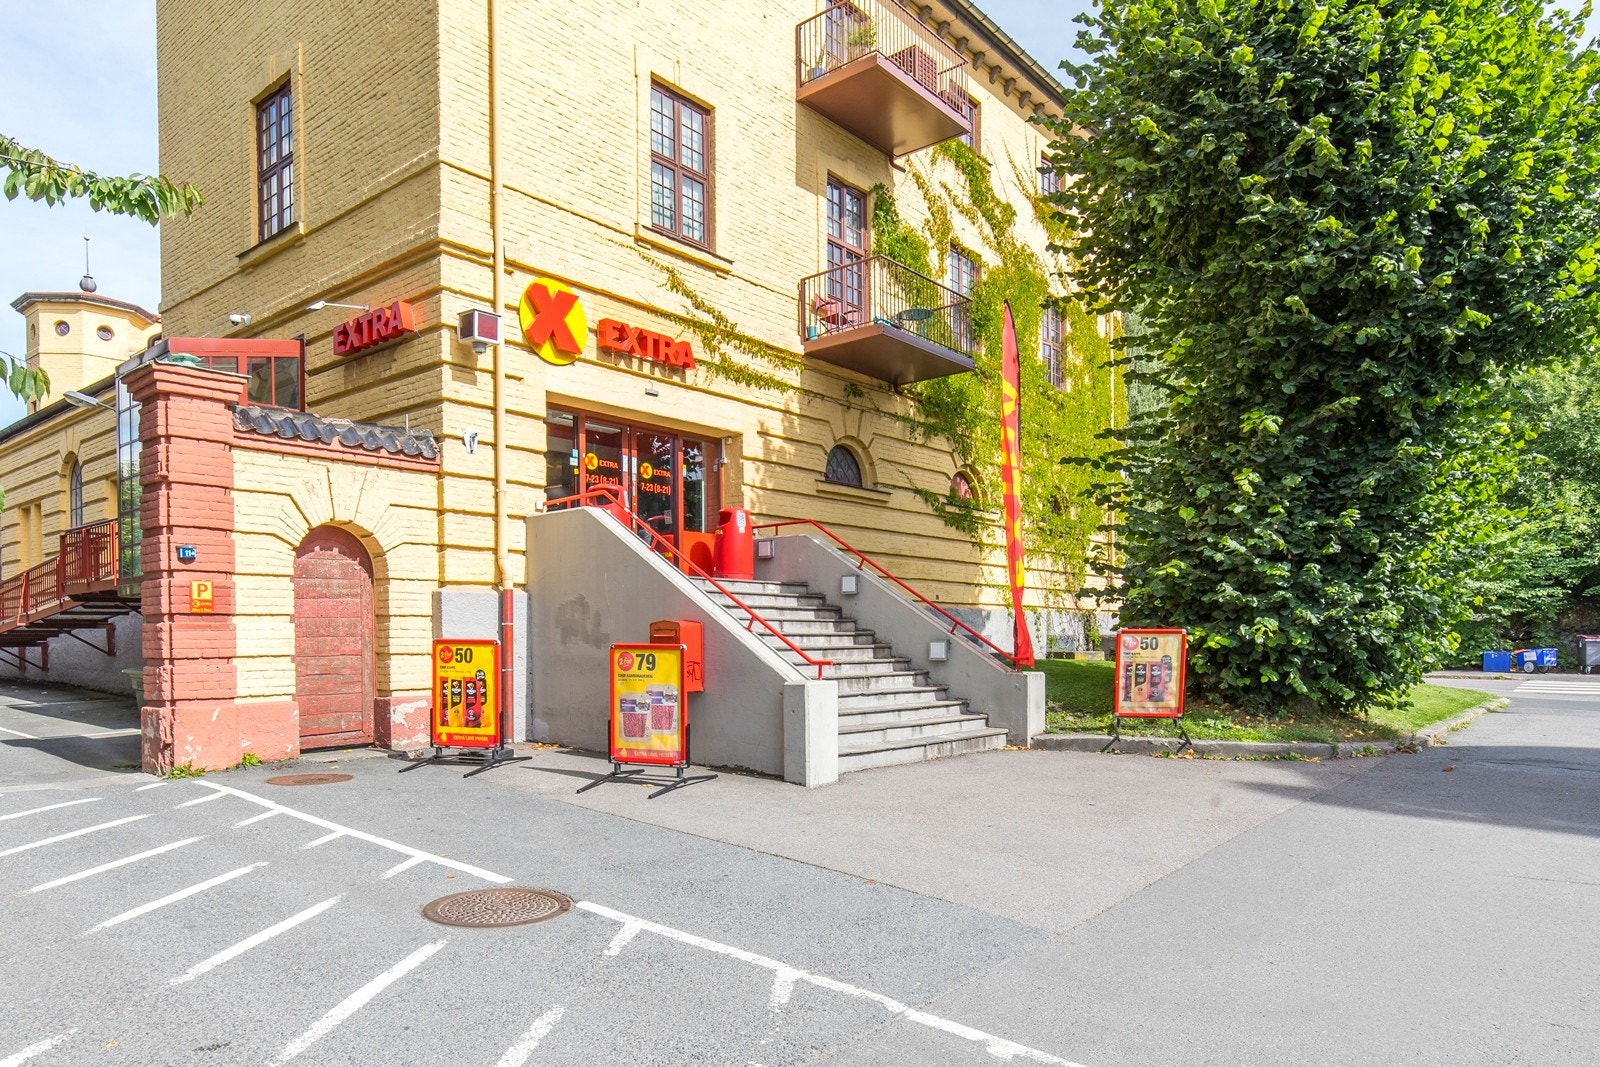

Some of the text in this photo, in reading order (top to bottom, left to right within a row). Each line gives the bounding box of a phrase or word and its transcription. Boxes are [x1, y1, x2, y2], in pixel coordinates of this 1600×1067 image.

[525, 282, 582, 355] X
[333, 300, 404, 356] EXTRA
[598, 318, 696, 369] EXTRA
[599, 459, 618, 469] EXTRA
[653, 469, 671, 478] EXTRA
[641, 482, 671, 495] 7-23 (8-21)
[197, 583, 209, 598] P
[1140, 636, 1159, 650] 50
[455, 647, 473, 664] 50
[635, 653, 656, 671] 79
